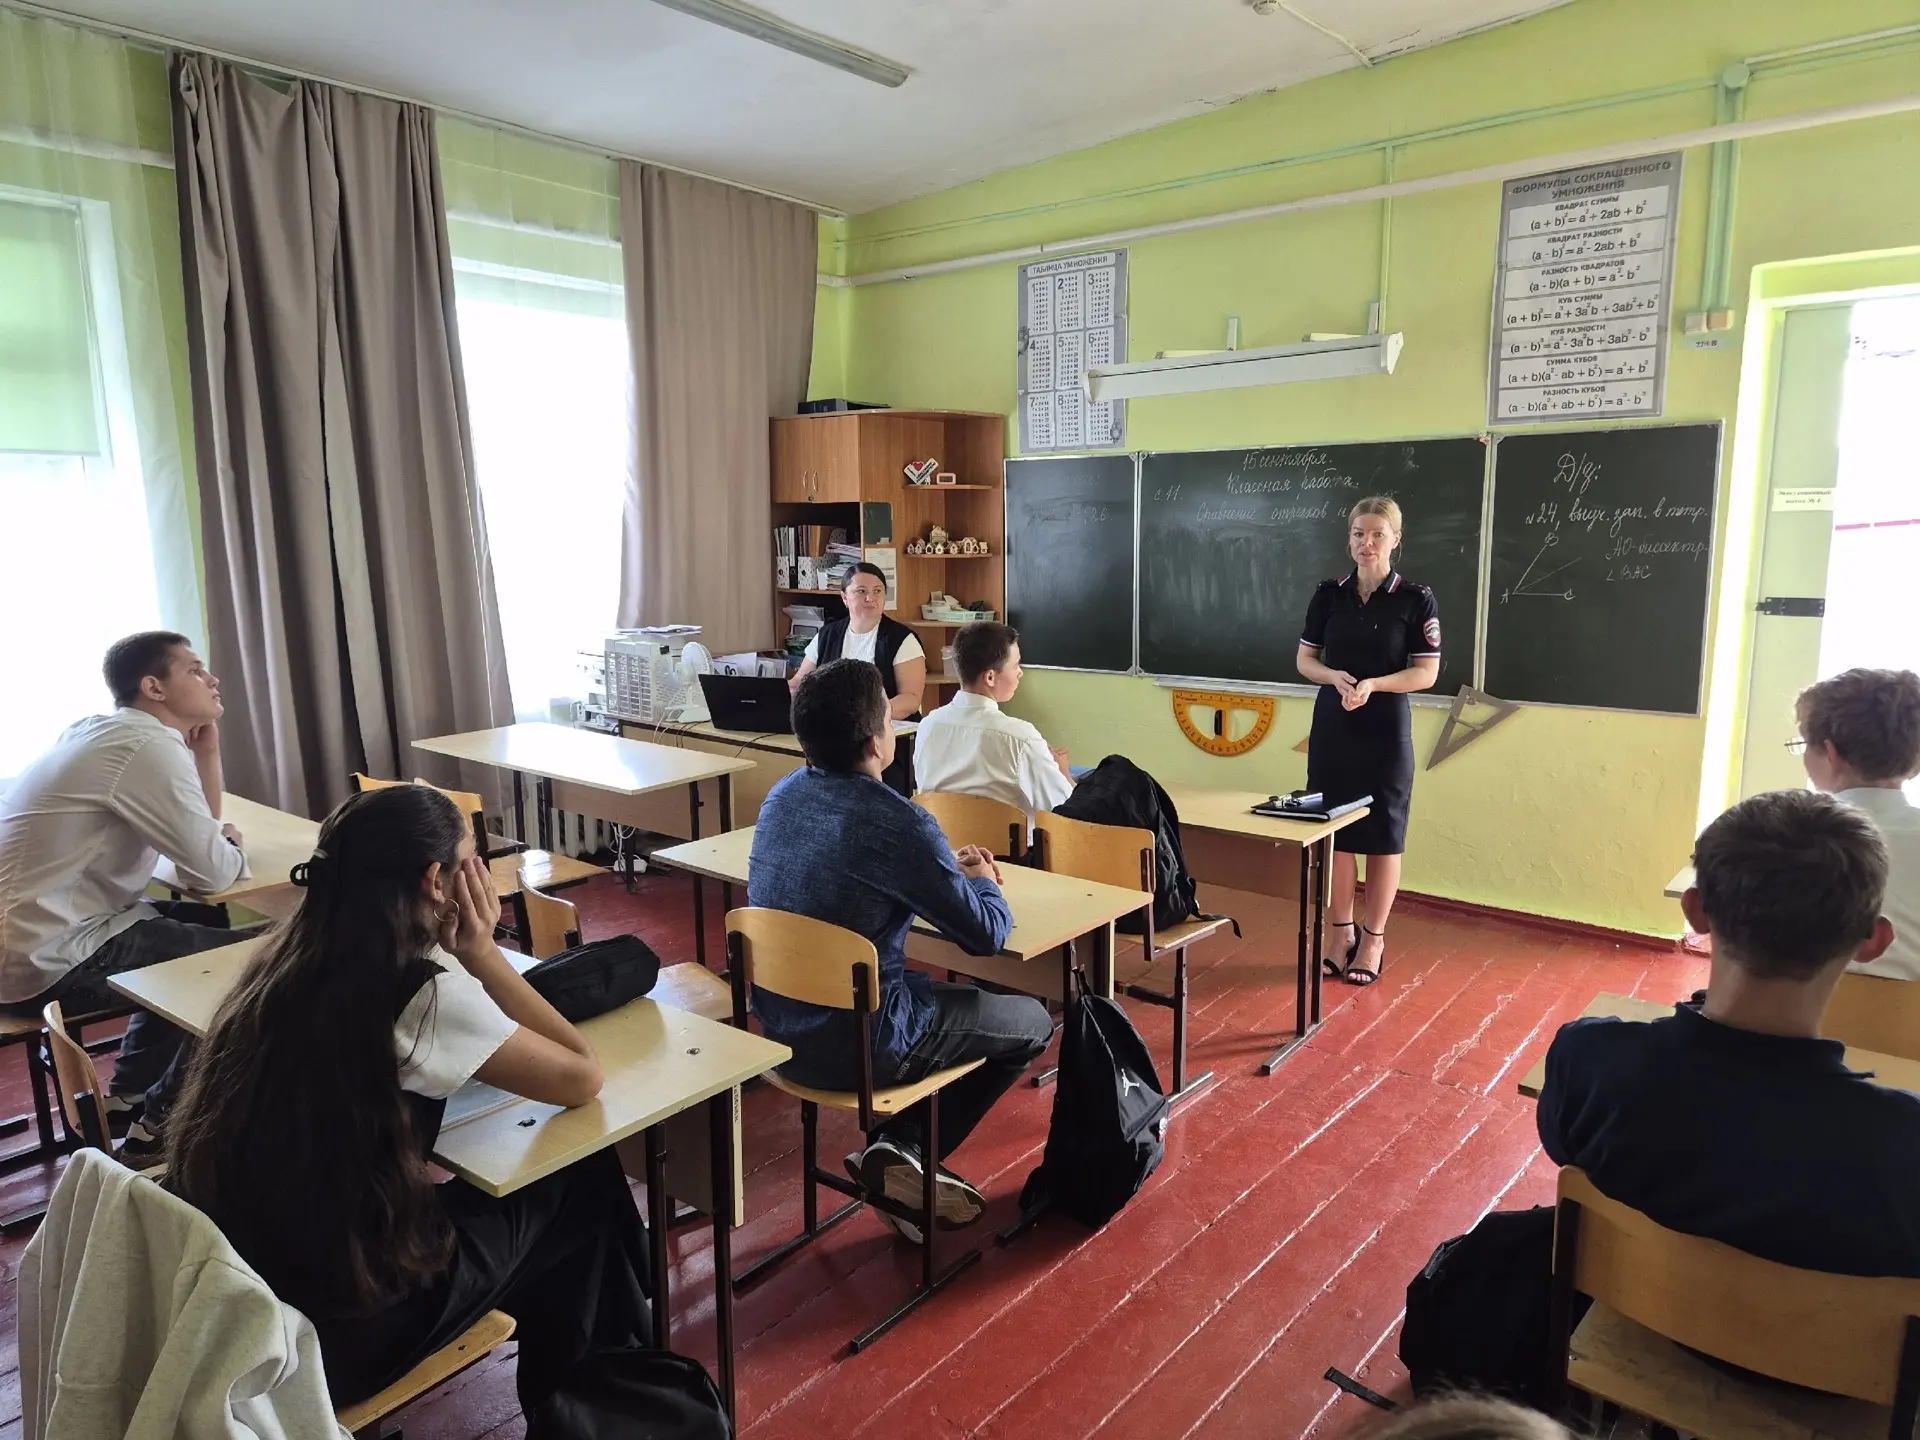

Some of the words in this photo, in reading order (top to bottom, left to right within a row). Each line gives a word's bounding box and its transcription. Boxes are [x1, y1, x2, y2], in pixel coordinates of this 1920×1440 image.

[1512, 178, 1570, 194] ФОРМУЛЫ
[1551, 179, 1625, 199] УМНОЖЕНИЯ
[1554, 201, 1588, 211] КВАДРАТ
[1590, 195, 1620, 207] СУММЫ
[1547, 234, 1580, 244] КВАДРАТ
[1583, 227, 1623, 239] РАЗНОСТИ
[1033, 264, 1062, 274] ТАБЛИЦА
[1063, 256, 1108, 270] УМНОЖЕНИЯ
[1541, 266, 1578, 276] РАЗНОСТЬ
[1580, 260, 1625, 270] КВАДРАТОВ
[1558, 296, 1572, 304] КУБ
[1574, 294, 1603, 302] СУММЫ
[1550, 328, 1565, 336] КУБ
[1566, 324, 1606, 335] РАЗНОСТИ
[1546, 357, 1572, 366] СУММА
[1574, 355, 1598, 364] КУБОВ
[1543, 388, 1580, 396] РАЗНОСТЬ
[1582, 386, 1606, 394] КУБОВ
[1243, 451, 1260, 471] 15
